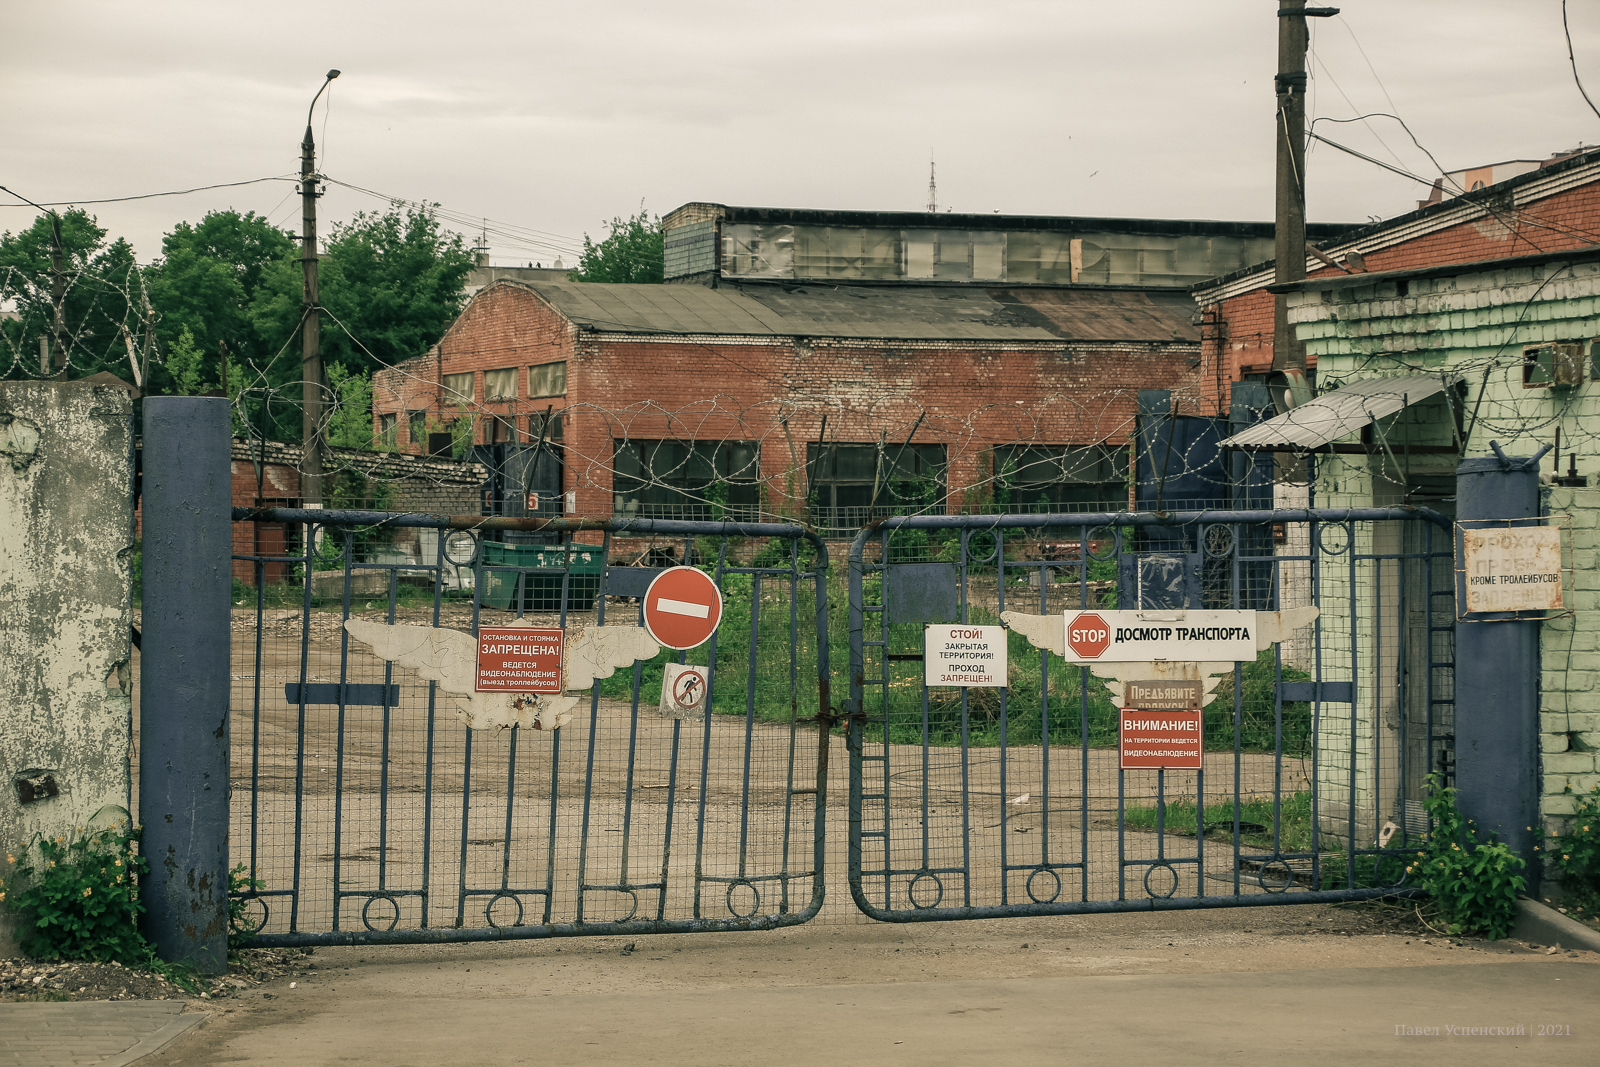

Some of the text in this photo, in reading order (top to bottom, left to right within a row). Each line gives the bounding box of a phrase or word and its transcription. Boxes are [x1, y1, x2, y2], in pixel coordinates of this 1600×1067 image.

[1470, 573, 1559, 586] КРОМЕ ТРОЛЛЕЙБУСОВ
[482, 634, 522, 642] ОСТАНОВКА
[950, 629, 983, 640] СТОЙ!
[1072, 629, 1106, 643] STOP
[1115, 627, 1250, 643] ДОСМОТР ТРАНСПОРТА
[481, 644, 560, 656] ЗАПРЕЩЕНА!
[944, 642, 988, 650] ЗАКРЫТАЯ
[939, 651, 994, 660] ТЕРРИТОРИЯ!
[502, 661, 537, 669] ВЕДЕТСЯ
[948, 664, 985, 673] ПРОХОД
[480, 670, 556, 678] ВИДЕОНАБЛЮДЕНИЕ
[940, 674, 993, 683] ЗАПРЕЩЕН!
[480, 679, 558, 687] (выезд троллейбусов)
[1124, 719, 1198, 732] ВНИМАНИЕ!
[1124, 750, 1198, 758] ВИДЕОНАБЛЮДЕНИЕ
